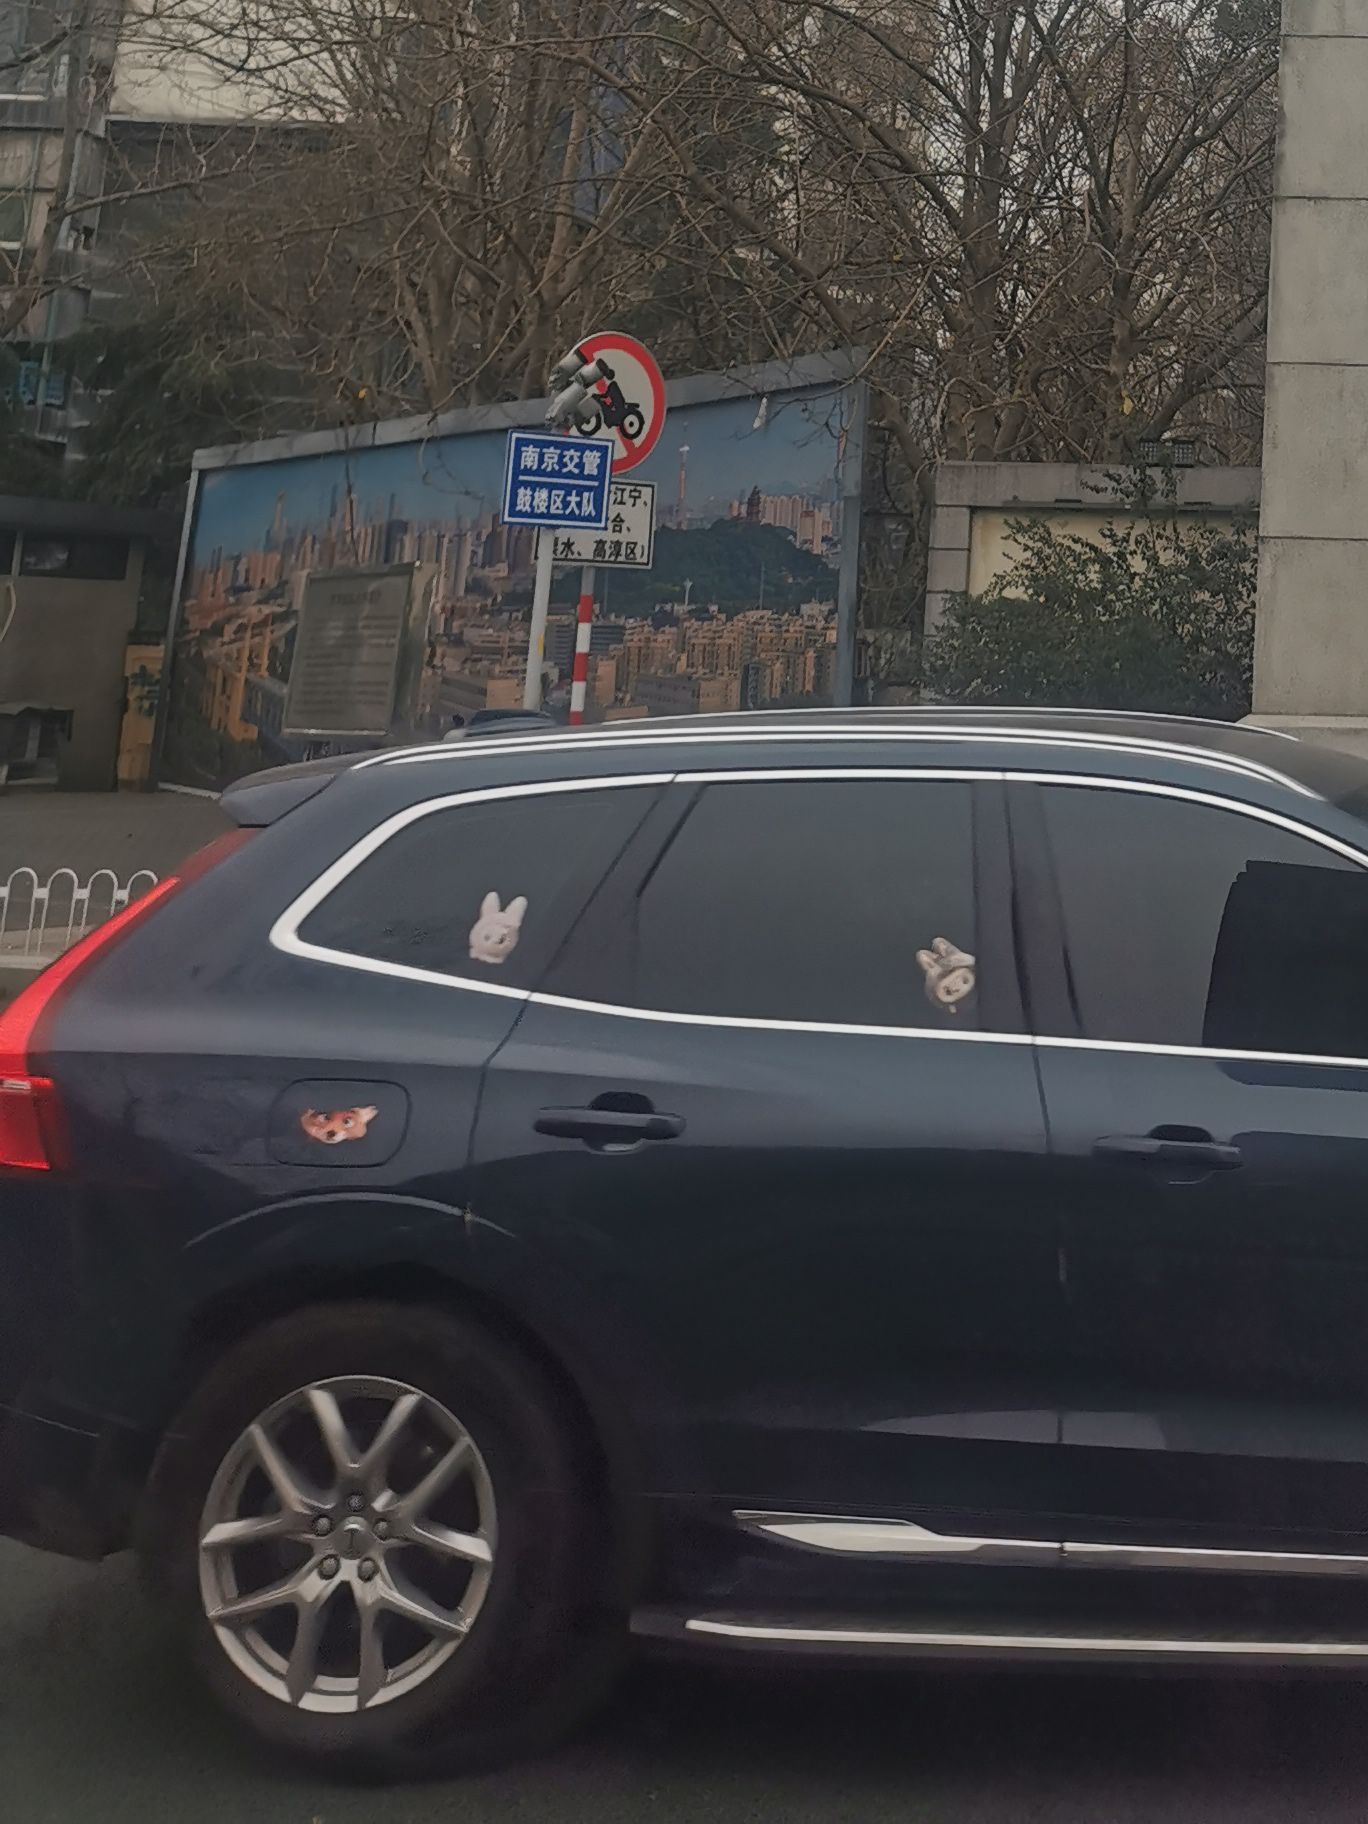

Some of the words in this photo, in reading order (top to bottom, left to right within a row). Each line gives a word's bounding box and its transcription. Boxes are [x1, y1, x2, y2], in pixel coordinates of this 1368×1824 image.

[520, 444, 602, 476] 南京交管
[515, 486, 596, 518] 鼓楼区大队
[609, 486, 649, 508] 江宁、
